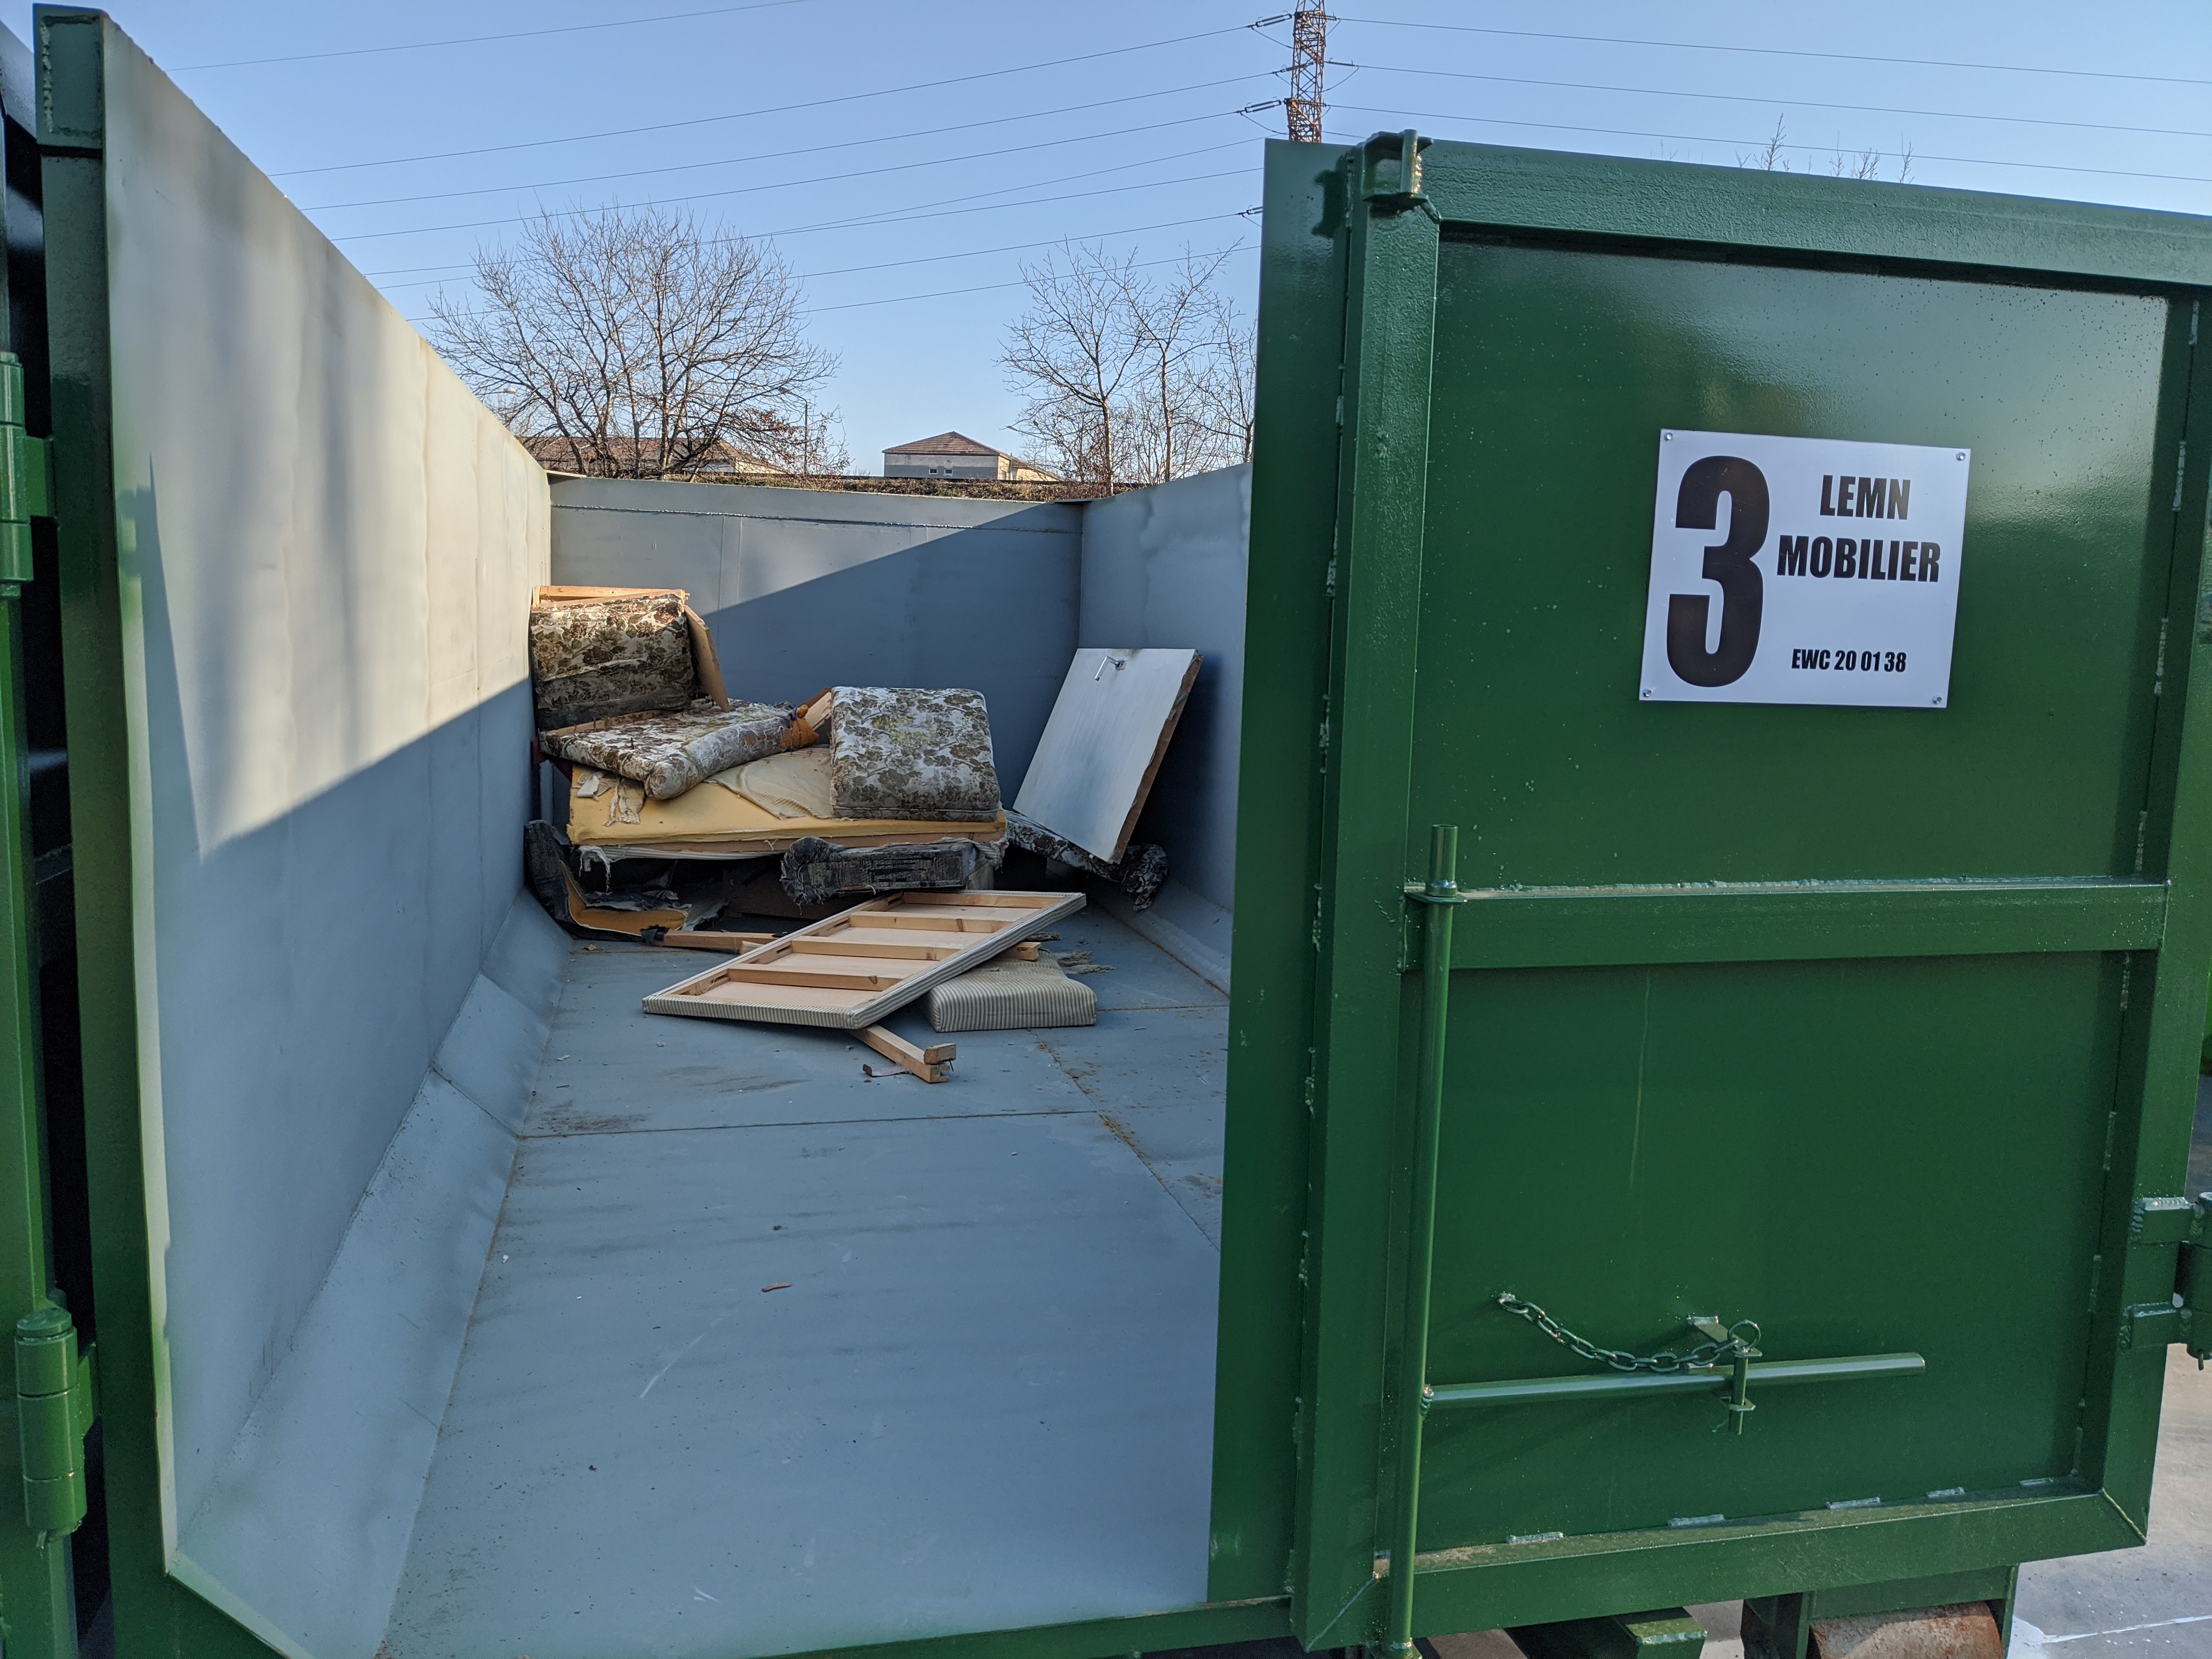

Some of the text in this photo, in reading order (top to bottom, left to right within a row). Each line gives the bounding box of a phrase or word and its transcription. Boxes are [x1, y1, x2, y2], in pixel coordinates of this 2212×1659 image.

[1820, 475, 1911, 520] LEMN
[1667, 455, 1770, 687] 3
[1777, 535, 1940, 582] MOBILIER
[1792, 648, 1906, 673] EWC 20 01 38
